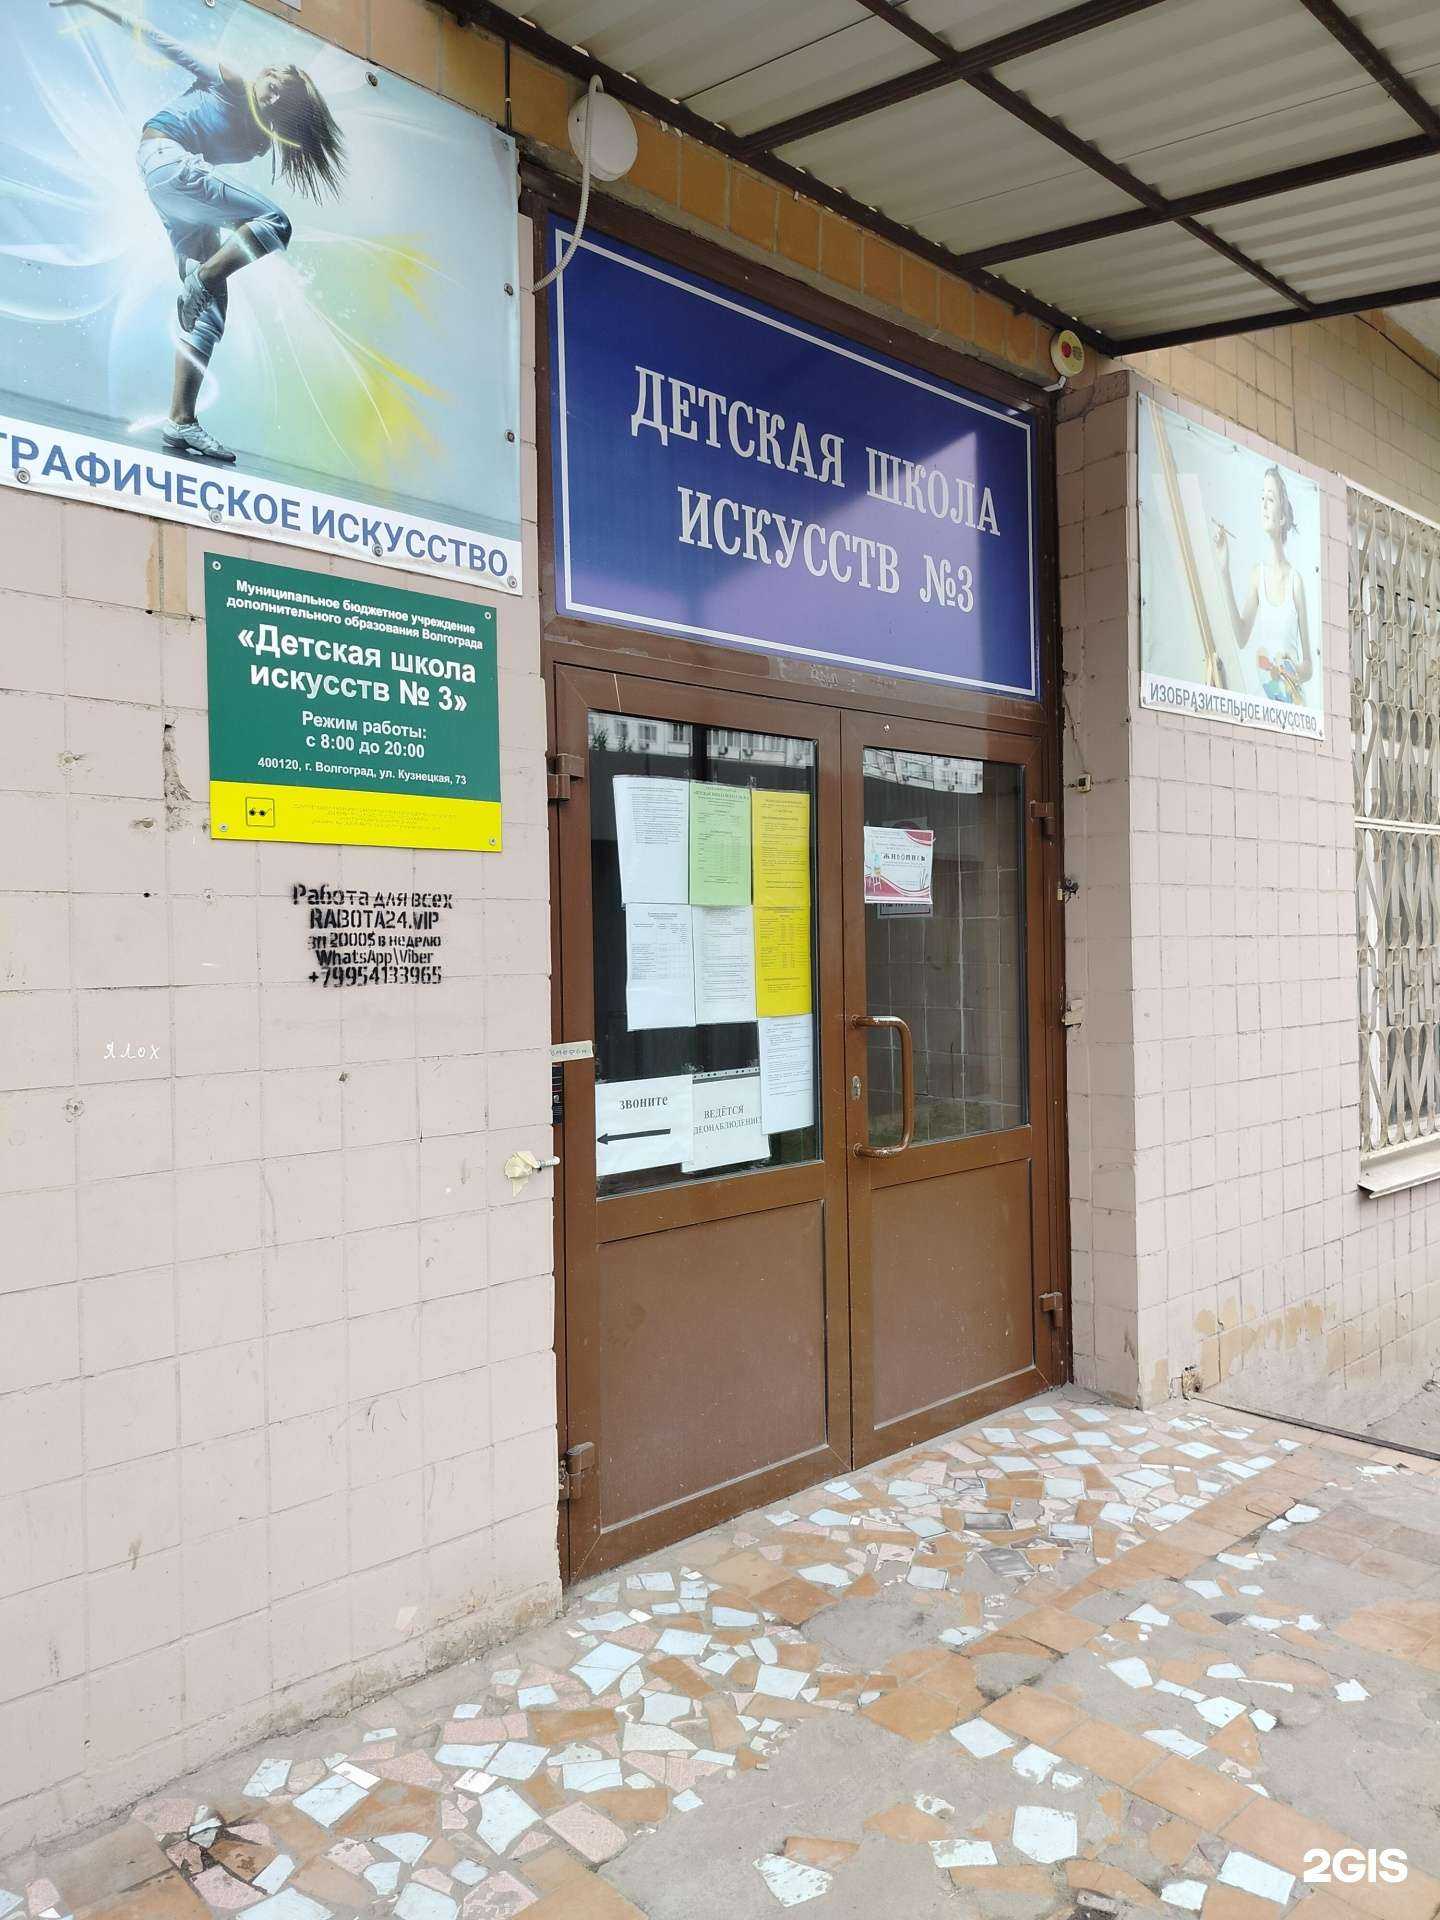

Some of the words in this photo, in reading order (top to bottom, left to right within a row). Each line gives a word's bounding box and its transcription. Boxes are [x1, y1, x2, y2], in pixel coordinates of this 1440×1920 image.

[630, 365, 846, 489] ДЕТСКАЯ
[866, 446, 1001, 537] ШКОЛА
[311, 505, 508, 578] ИСКУССТВО
[677, 486, 900, 595] ИСКУССТВ
[919, 554, 975, 613] №3
[236, 579, 340, 610] Муниципальное
[343, 599, 408, 622] бюджетное
[411, 613, 476, 635] учреждение
[226, 596, 342, 625] дополнительного
[344, 615, 420, 639] образования
[422, 629, 484, 650] Волгограда
[237, 623, 381, 668] «Детская
[391, 651, 477, 684] школа
[250, 664, 390, 702] искусств
[400, 679, 430, 707] №
[438, 685, 469, 713] 3»
[1150, 683, 1261, 721] ИЗОБРАЗИТЕЛЬНОЕ
[1263, 704, 1317, 731] ИСКУССТВО
[302, 711, 358, 732] Режим
[363, 720, 428, 740] работы:
[306, 736, 316, 748] с
[320, 733, 355, 752] 8:00
[359, 741, 381, 756] до
[384, 740, 425, 759] 20:00
[257, 756, 302, 772] 400120,
[305, 762, 312, 772] г.
[315, 761, 377, 779] Волгоград,
[379, 766, 396, 780] ул.
[398, 769, 453, 786] Кузнецкая,
[455, 774, 468, 785] 73
[292, 883, 369, 906] Работа
[373, 891, 408, 909] для
[411, 892, 453, 910] всех
[309, 908, 440, 930] RABOTA24.VIP
[329, 931, 376, 949] 2000$
[378, 936, 386, 947] в
[308, 966, 442, 988] +79954133965
[693, 1116, 760, 1135] ДЕОНАБЛЮДЕНИЕ
[704, 1104, 744, 1119] ВЕДЁТСЯ
